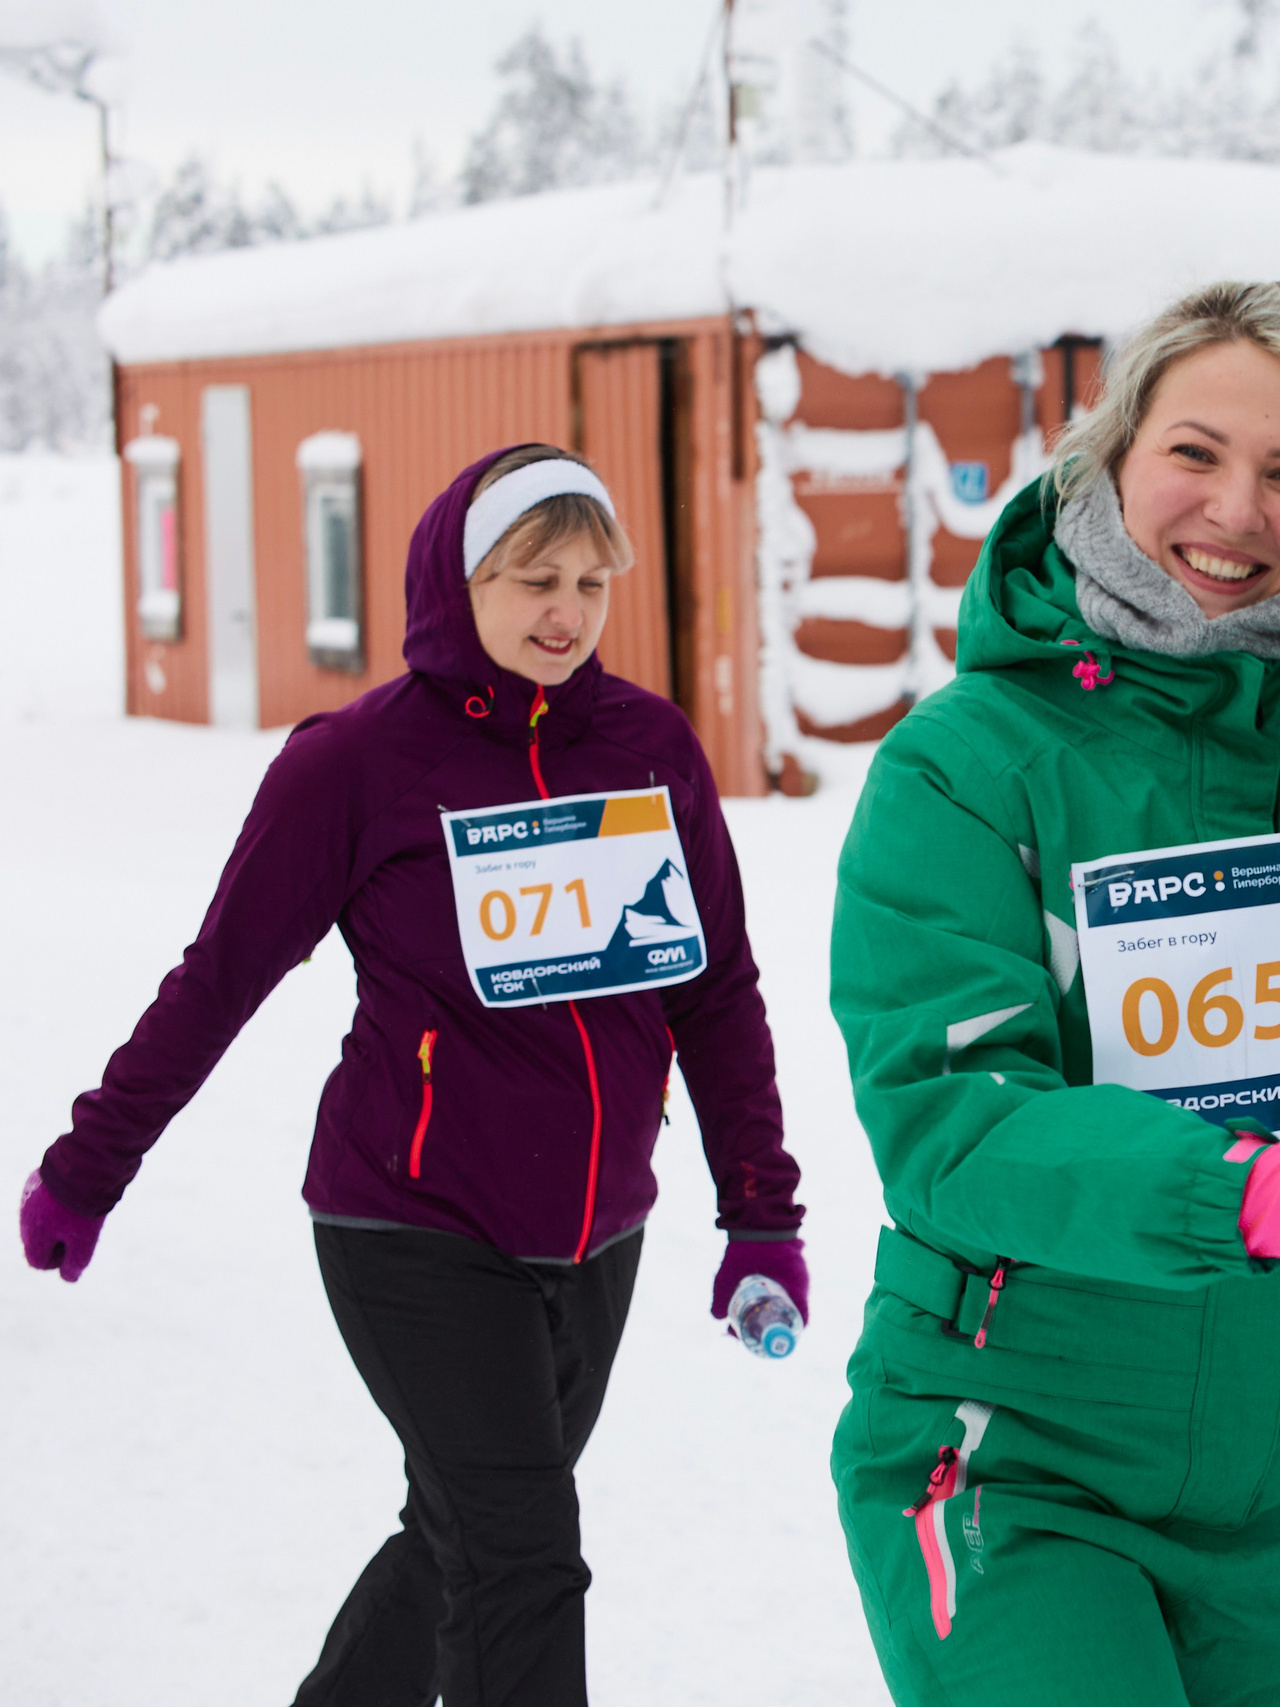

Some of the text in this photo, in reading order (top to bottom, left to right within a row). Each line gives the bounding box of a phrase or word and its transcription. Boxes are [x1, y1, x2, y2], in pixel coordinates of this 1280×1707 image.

[479, 878, 592, 942] 071
[1117, 931, 1217, 953] Забег в гору
[490, 956, 601, 984] КОВДОРСКИЙ
[493, 977, 525, 995] ГОК
